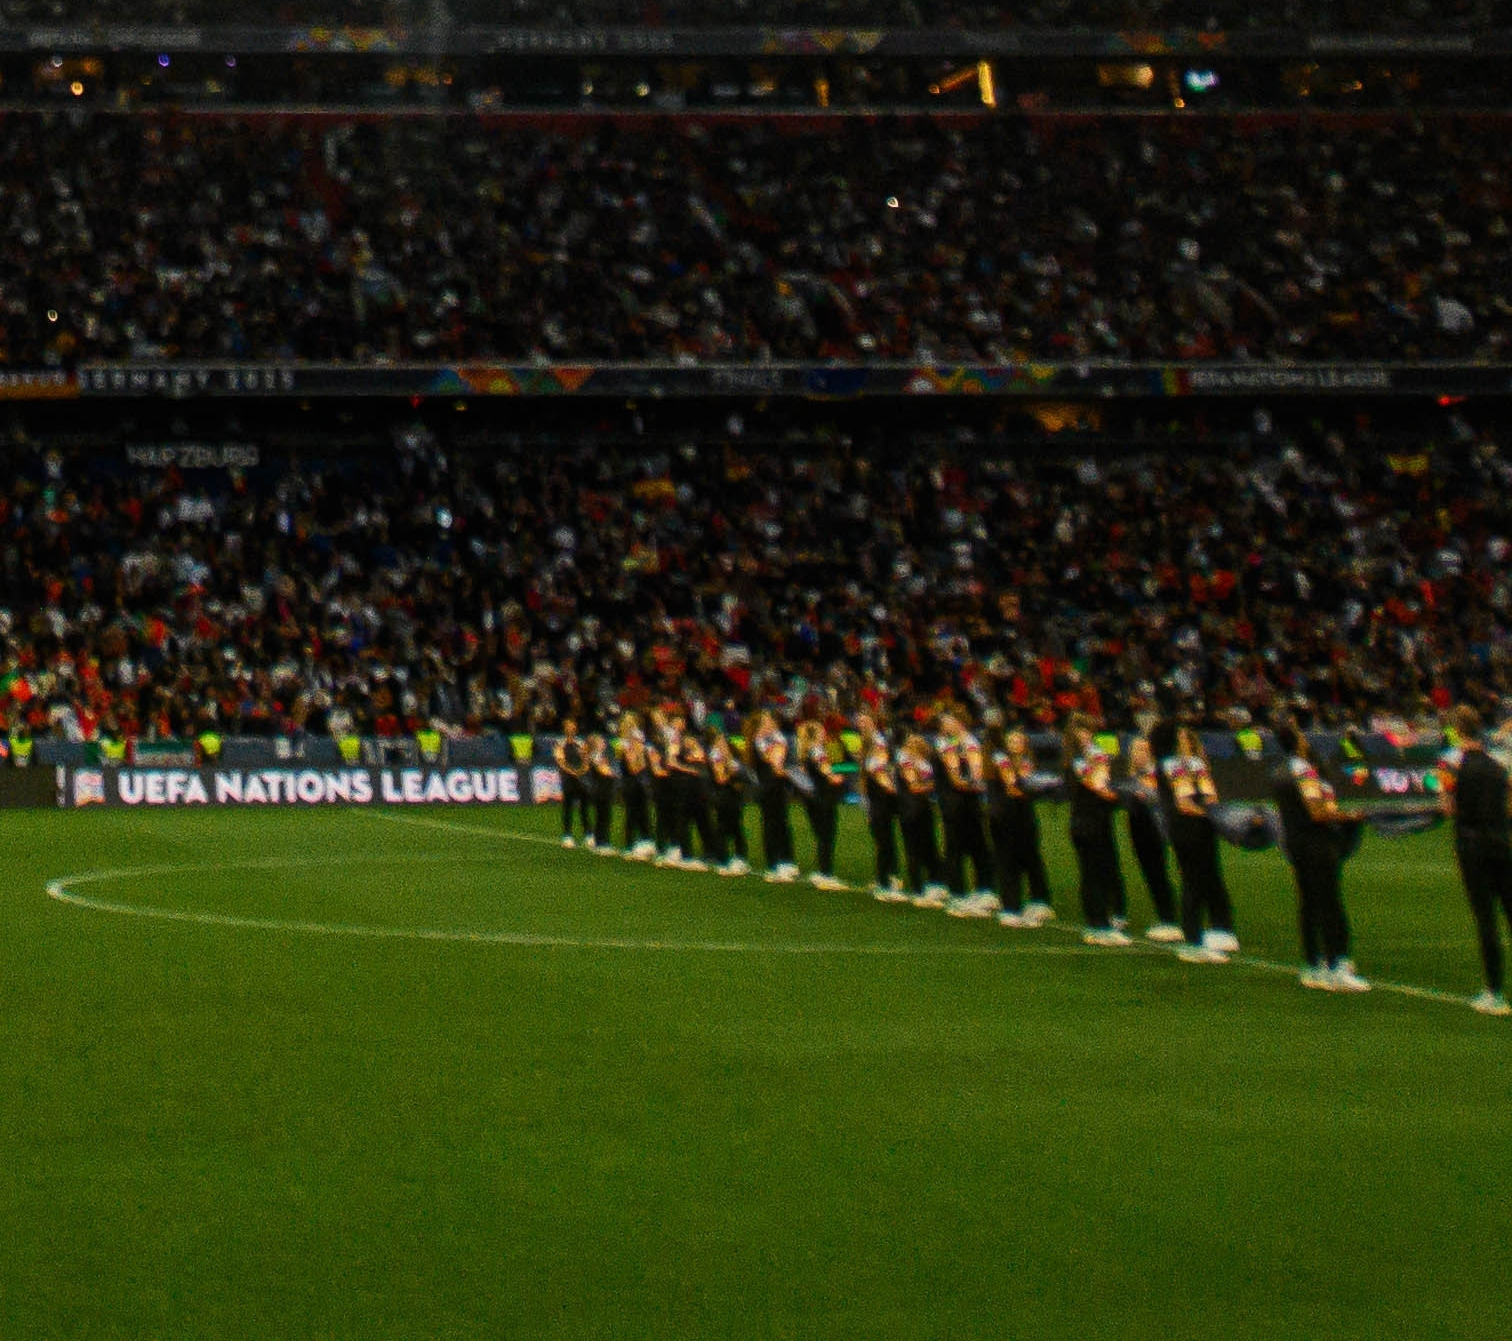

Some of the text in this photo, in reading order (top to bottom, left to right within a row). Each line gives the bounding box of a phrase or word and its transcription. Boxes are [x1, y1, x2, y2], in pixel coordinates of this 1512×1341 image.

[117, 768, 520, 804] UEFA NATIONS LEAGUE
